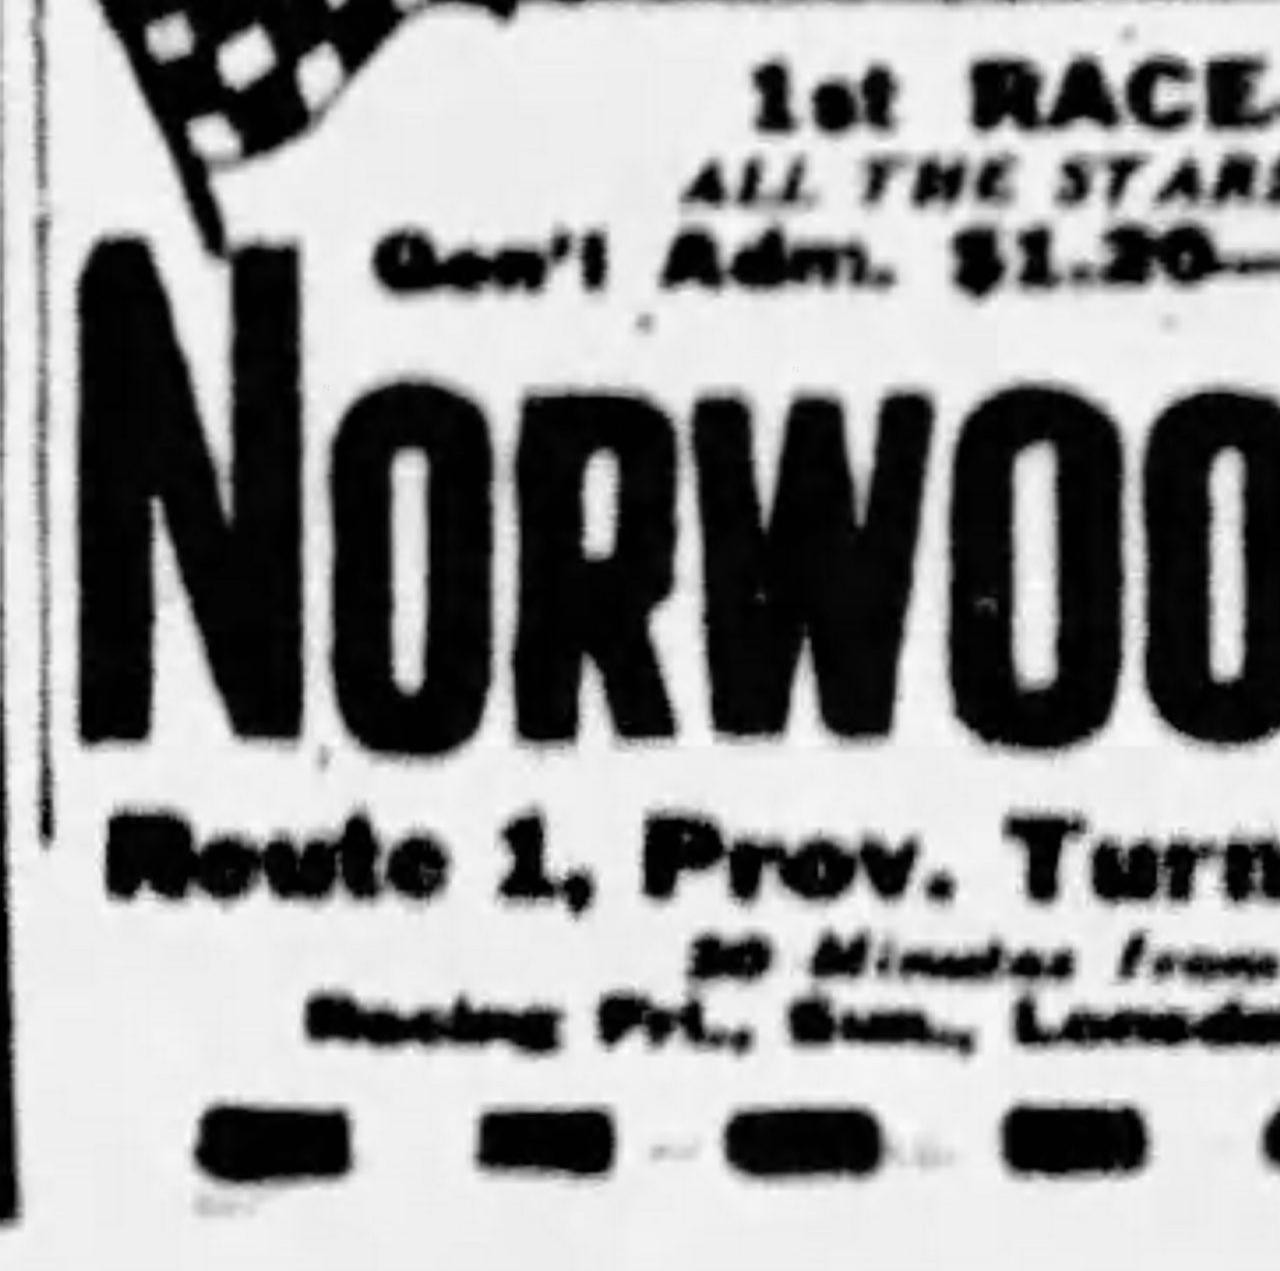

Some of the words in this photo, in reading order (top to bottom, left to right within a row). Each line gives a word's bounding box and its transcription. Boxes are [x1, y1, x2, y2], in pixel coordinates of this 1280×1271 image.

[751, 59, 900, 136] 1st
[680, 157, 812, 209] ALL
[862, 155, 1014, 209] THE
[659, 224, 896, 292] Adm.
[102, 807, 451, 903] Route
[495, 809, 596, 917] 1,
[639, 811, 957, 905] Prov.
